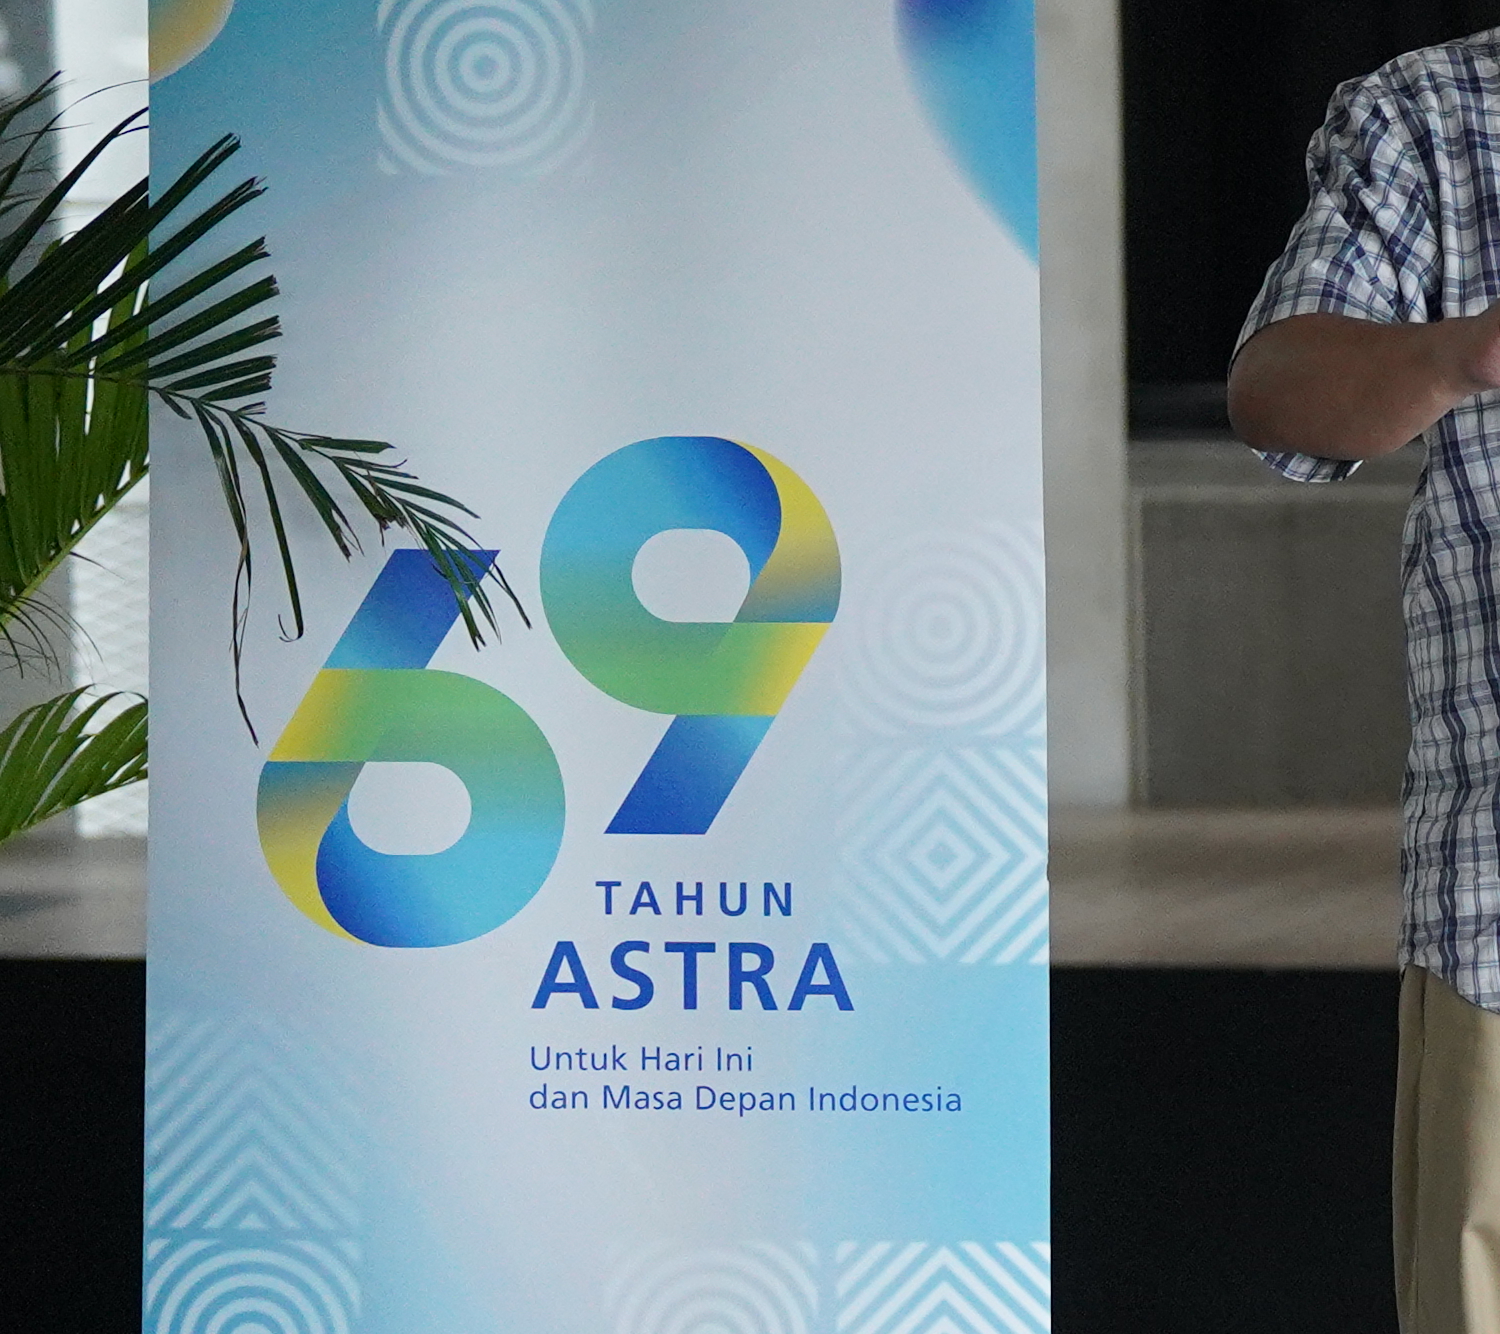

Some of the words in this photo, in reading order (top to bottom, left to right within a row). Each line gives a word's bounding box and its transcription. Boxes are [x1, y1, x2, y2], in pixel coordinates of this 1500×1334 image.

[256, 435, 842, 949] 69
[597, 881, 793, 916] TAHUN
[530, 940, 855, 1011] ASTRA
[530, 1046, 628, 1072] Untuk
[640, 1046, 703, 1072] Hari
[716, 1046, 754, 1072] Ini
[529, 1084, 589, 1110] dan
[602, 1085, 683, 1111] Masa
[695, 1085, 796, 1117] Depan
[809, 1086, 963, 1114] Indonesia
